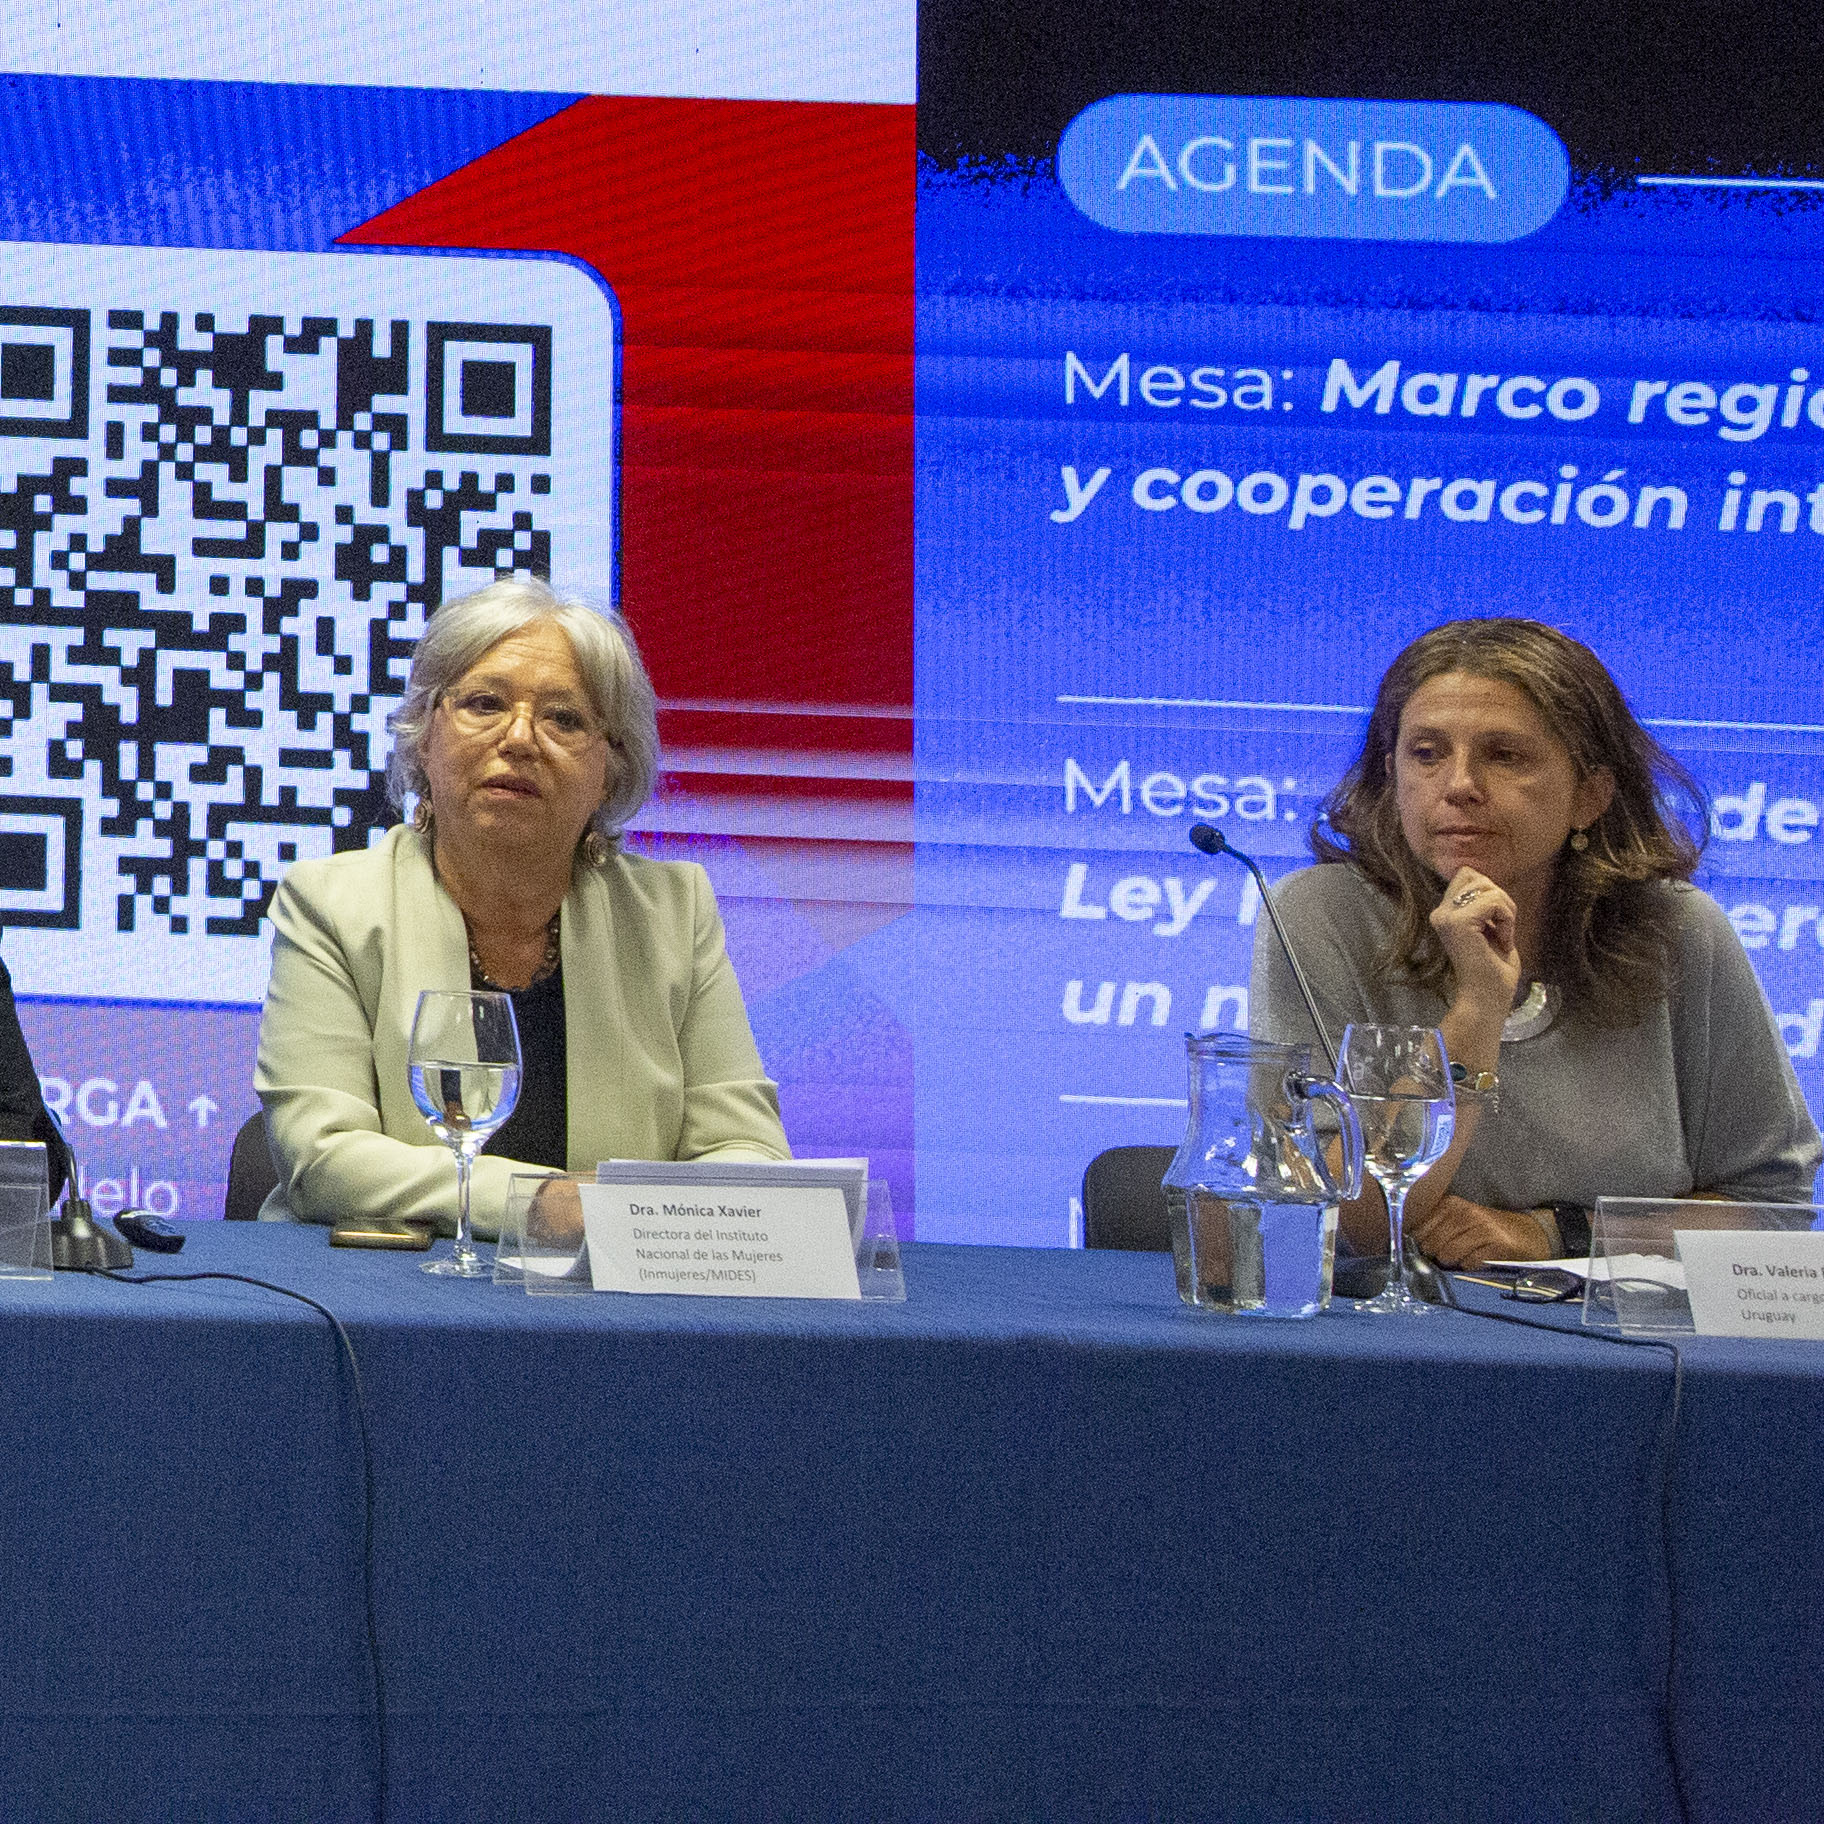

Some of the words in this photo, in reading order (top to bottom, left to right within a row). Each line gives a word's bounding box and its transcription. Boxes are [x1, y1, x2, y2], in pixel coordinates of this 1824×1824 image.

[1116, 134, 1498, 200] AGENDA
[1064, 352, 1294, 412] Mesa:
[1321, 359, 1601, 423] Marco
[1051, 466, 1111, 524] y
[1132, 466, 1689, 530] cooperación
[1064, 757, 1297, 821] Mesa:
[1060, 863, 1218, 937] Ley
[1062, 979, 1172, 1027] un
[630, 1203, 659, 1216] Dra.
[663, 1204, 714, 1218] Mónica
[718, 1205, 762, 1218] Xavier
[633, 1228, 690, 1241] Directora
[695, 1228, 712, 1241] del
[716, 1229, 768, 1242] Instituto
[636, 1248, 689, 1261] Nacional
[693, 1249, 708, 1261] de
[712, 1250, 728, 1262] las
[732, 1249, 783, 1264] Mujeres
[639, 1267, 756, 1283] (Inmujeres/MIDES)
[1733, 1264, 1763, 1276] Dra.
[1766, 1265, 1817, 1278] Valeria
